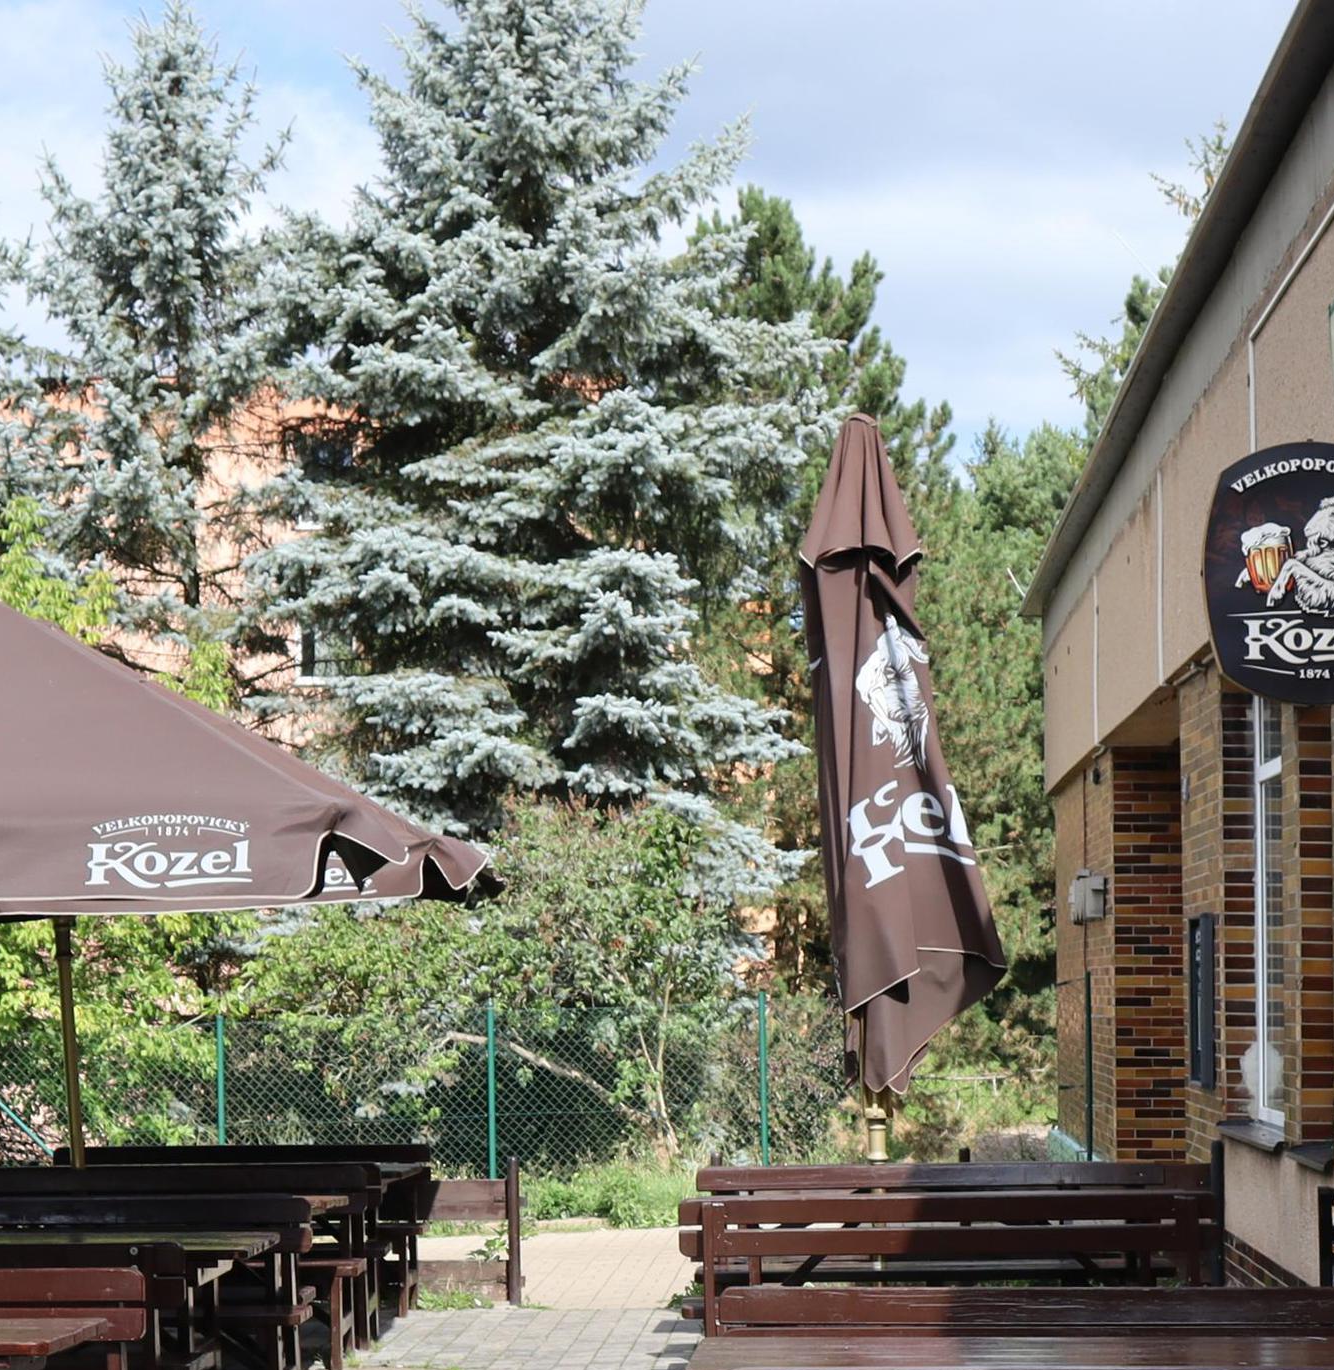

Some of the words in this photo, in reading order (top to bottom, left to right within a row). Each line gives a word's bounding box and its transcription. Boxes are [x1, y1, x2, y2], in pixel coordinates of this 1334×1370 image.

[1298, 668, 1331, 679] 1874
[92, 813, 251, 836] VELKOPOPOVICKÝ
[157, 826, 189, 836] 1874
[85, 839, 253, 888] Kozel
